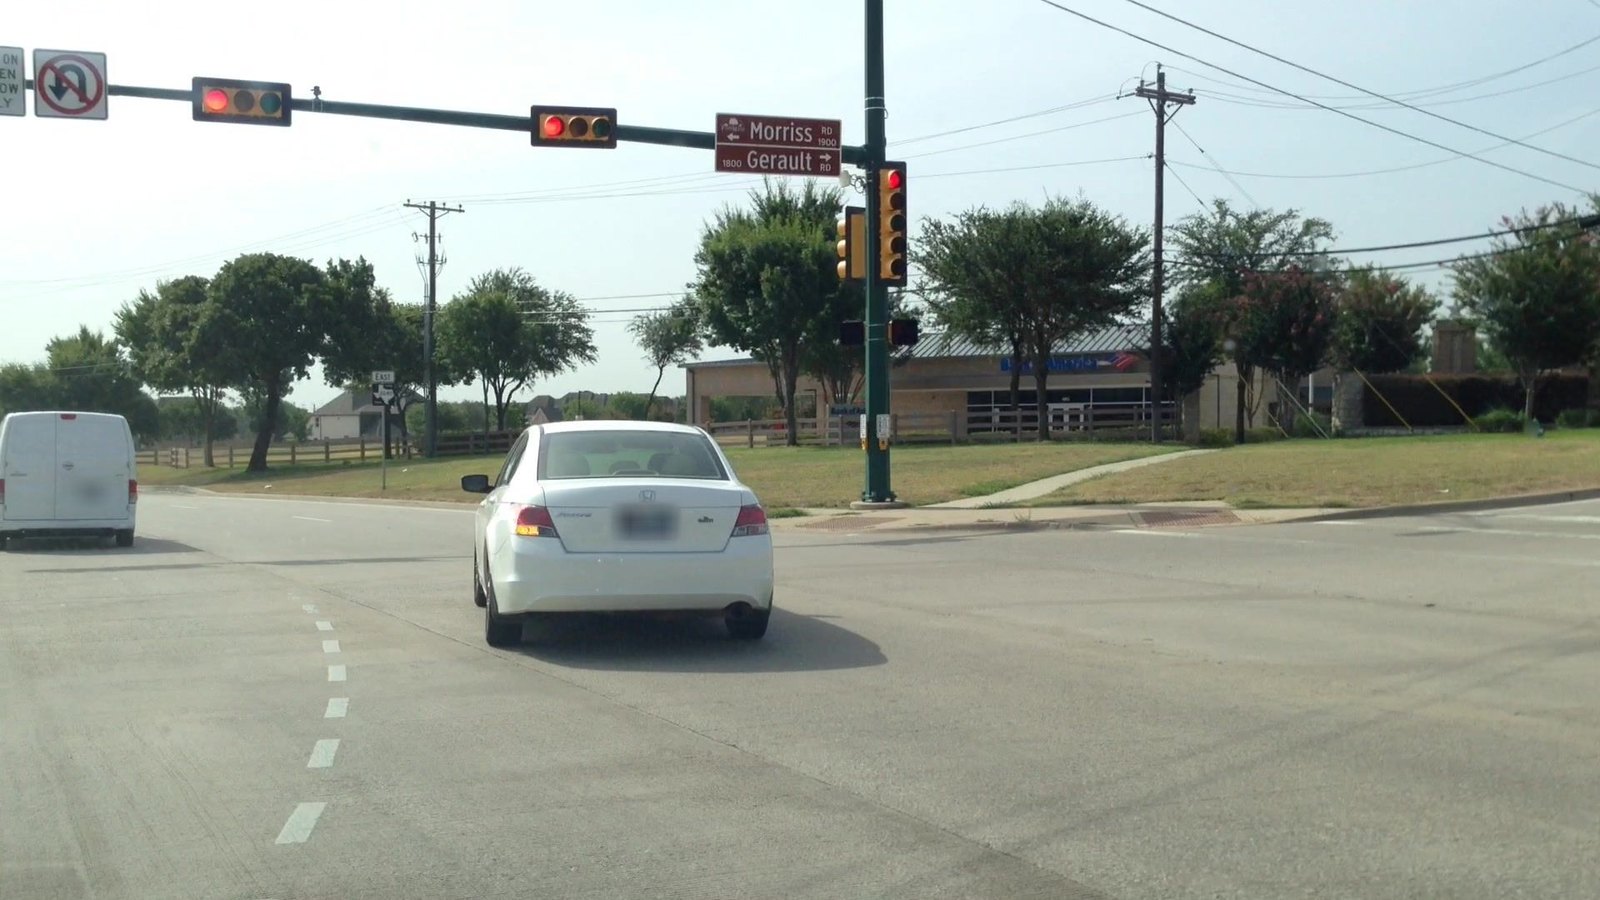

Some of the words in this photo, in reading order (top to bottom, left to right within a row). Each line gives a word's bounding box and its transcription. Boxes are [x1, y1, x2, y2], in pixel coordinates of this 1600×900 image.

[3, 53, 18, 65] ON
[750, 121, 813, 143] Morriss
[821, 126, 833, 136] RD
[818, 138, 837, 147] 1900
[722, 159, 742, 168] 1800
[747, 150, 812, 171] Gerault
[820, 163, 832, 172] RD
